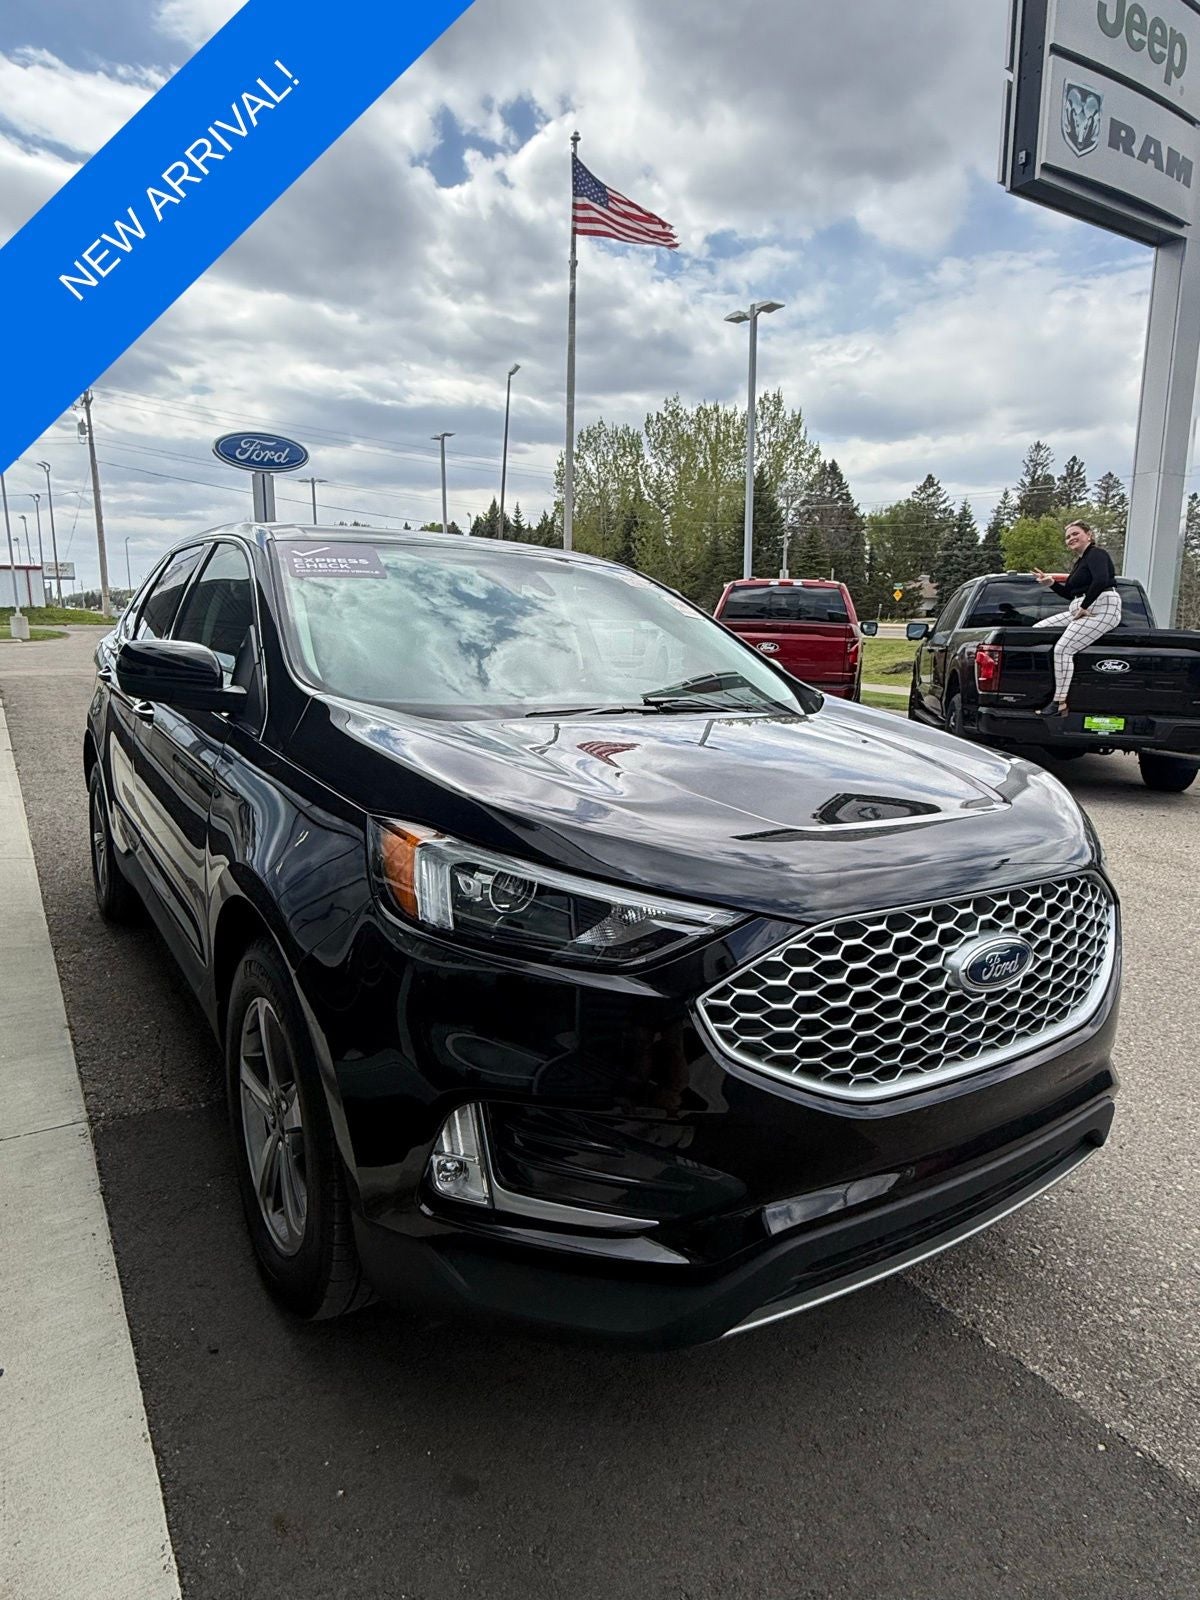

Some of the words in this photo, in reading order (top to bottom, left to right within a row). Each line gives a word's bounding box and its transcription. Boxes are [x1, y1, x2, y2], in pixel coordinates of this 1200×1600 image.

[1097, 0, 1188, 87] Jeep
[1108, 117, 1194, 189] RAM
[236, 438, 290, 464] Ford
[293, 557, 370, 565] EXPRESS
[294, 562, 352, 570] CHECK
[982, 949, 1020, 981] Ford
